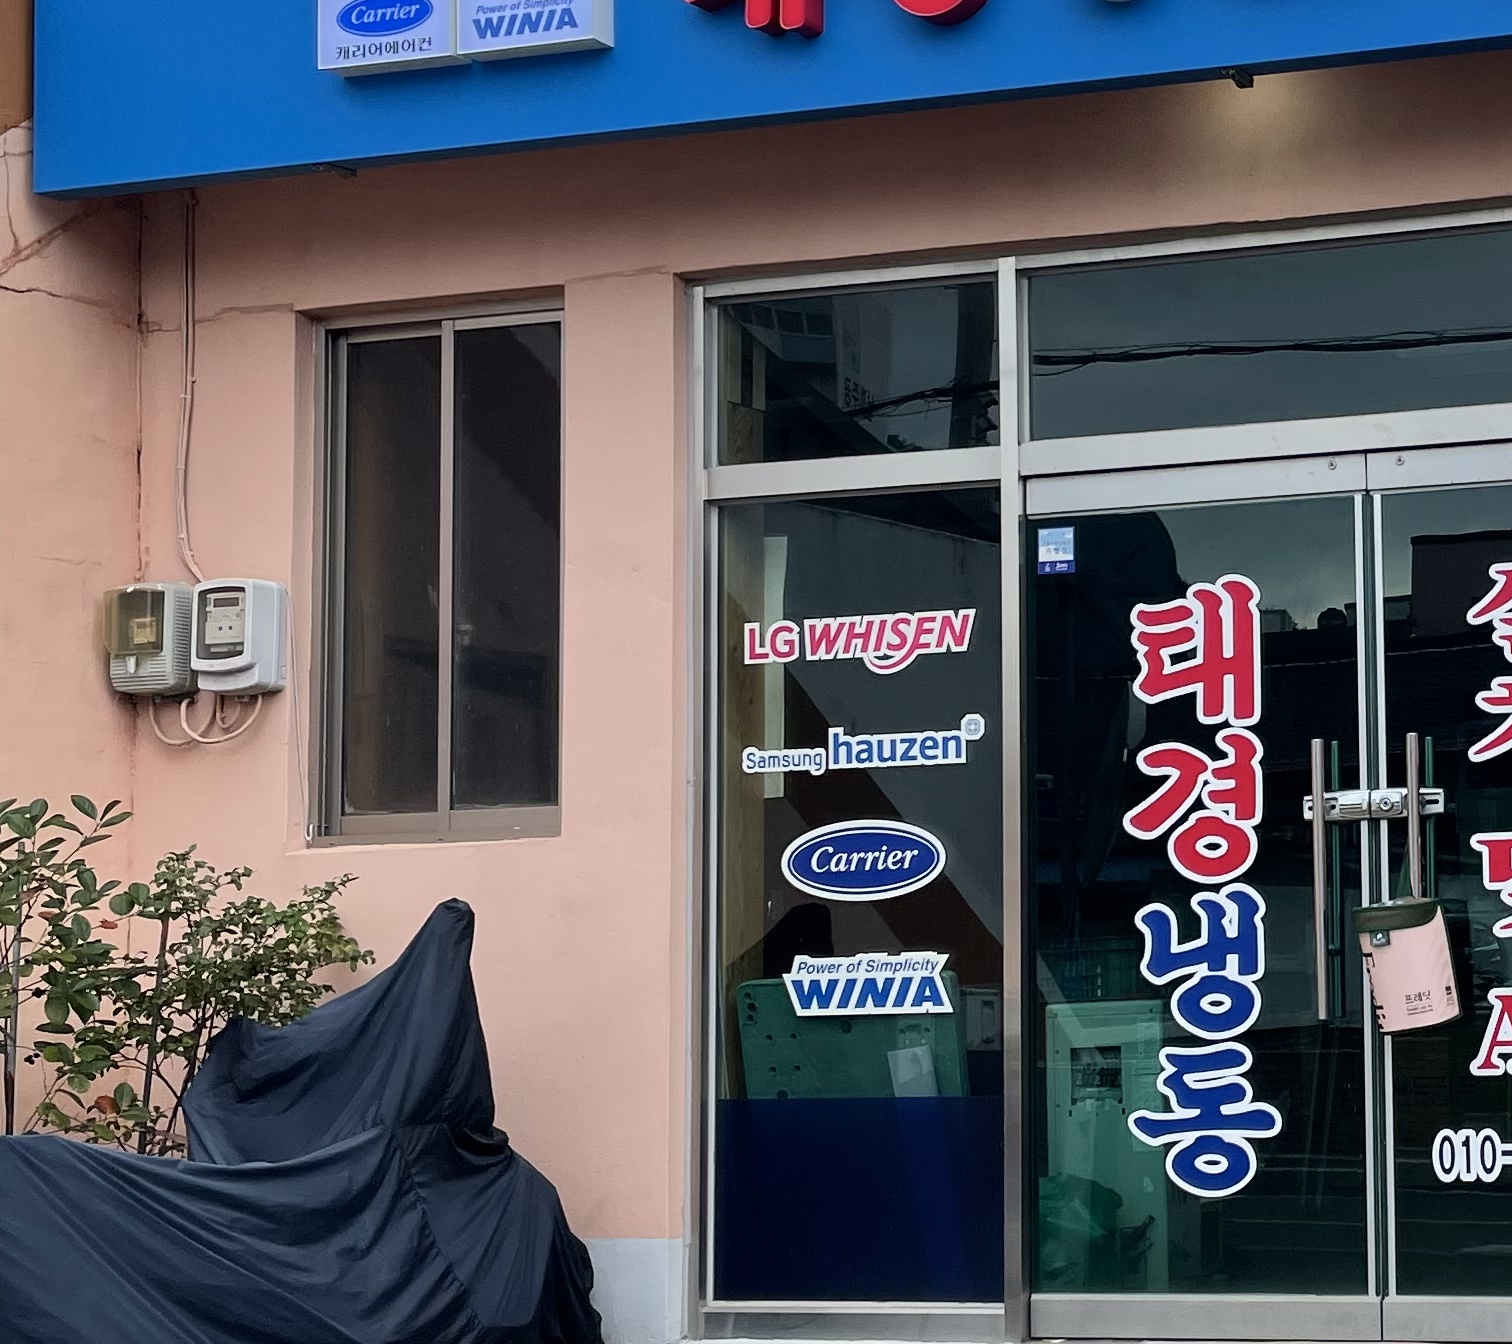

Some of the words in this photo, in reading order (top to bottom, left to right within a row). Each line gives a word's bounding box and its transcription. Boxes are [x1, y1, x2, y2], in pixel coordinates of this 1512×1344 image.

[350, 2, 421, 26] Carrier
[472, 7, 579, 40] WINIA
[475, 3, 508, 16] Power
[509, 0, 521, 11] of
[335, 37, 433, 60] 캐리어에어컨
[748, 624, 796, 661] LG
[807, 612, 972, 670] WHISEN
[745, 751, 823, 772] Samsung
[833, 731, 963, 766] hauzen
[810, 844, 919, 874] Carrier
[1127, 578, 1279, 1193] 태경냉동
[796, 960, 843, 975] Power
[847, 959, 862, 973] of
[865, 956, 939, 975] Simplicity
[791, 978, 945, 1010] WINIA
